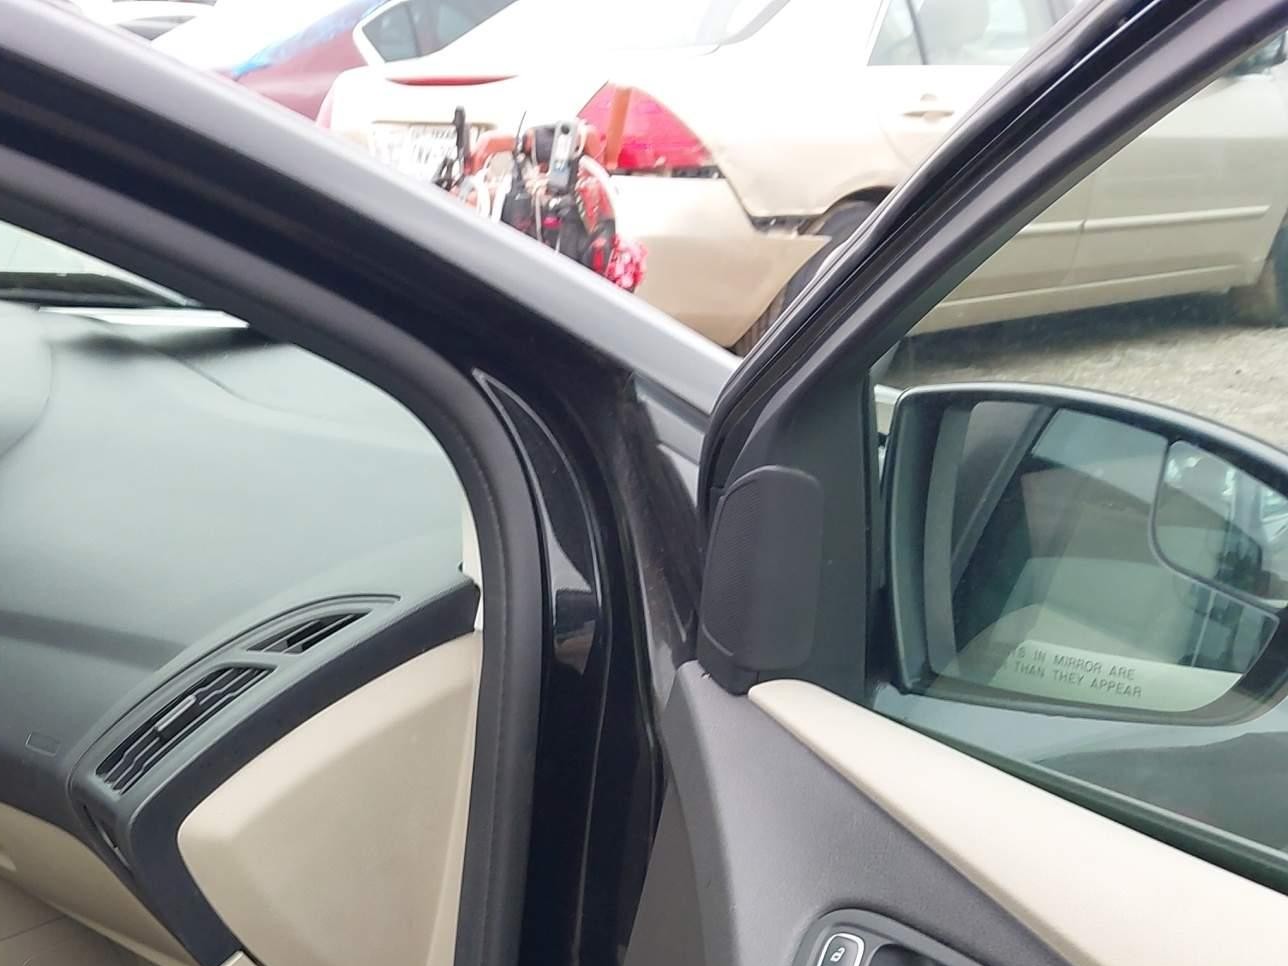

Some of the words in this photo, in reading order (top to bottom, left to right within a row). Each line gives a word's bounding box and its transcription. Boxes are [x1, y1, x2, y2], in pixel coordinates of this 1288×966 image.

[1015, 661, 1045, 679] THAN
[1053, 670, 1085, 686] THEY
[1090, 680, 1142, 698] APPEAR
[1033, 649, 1046, 662] IN
[1053, 654, 1102, 674] MIRROR
[1109, 664, 1137, 681] ARE
